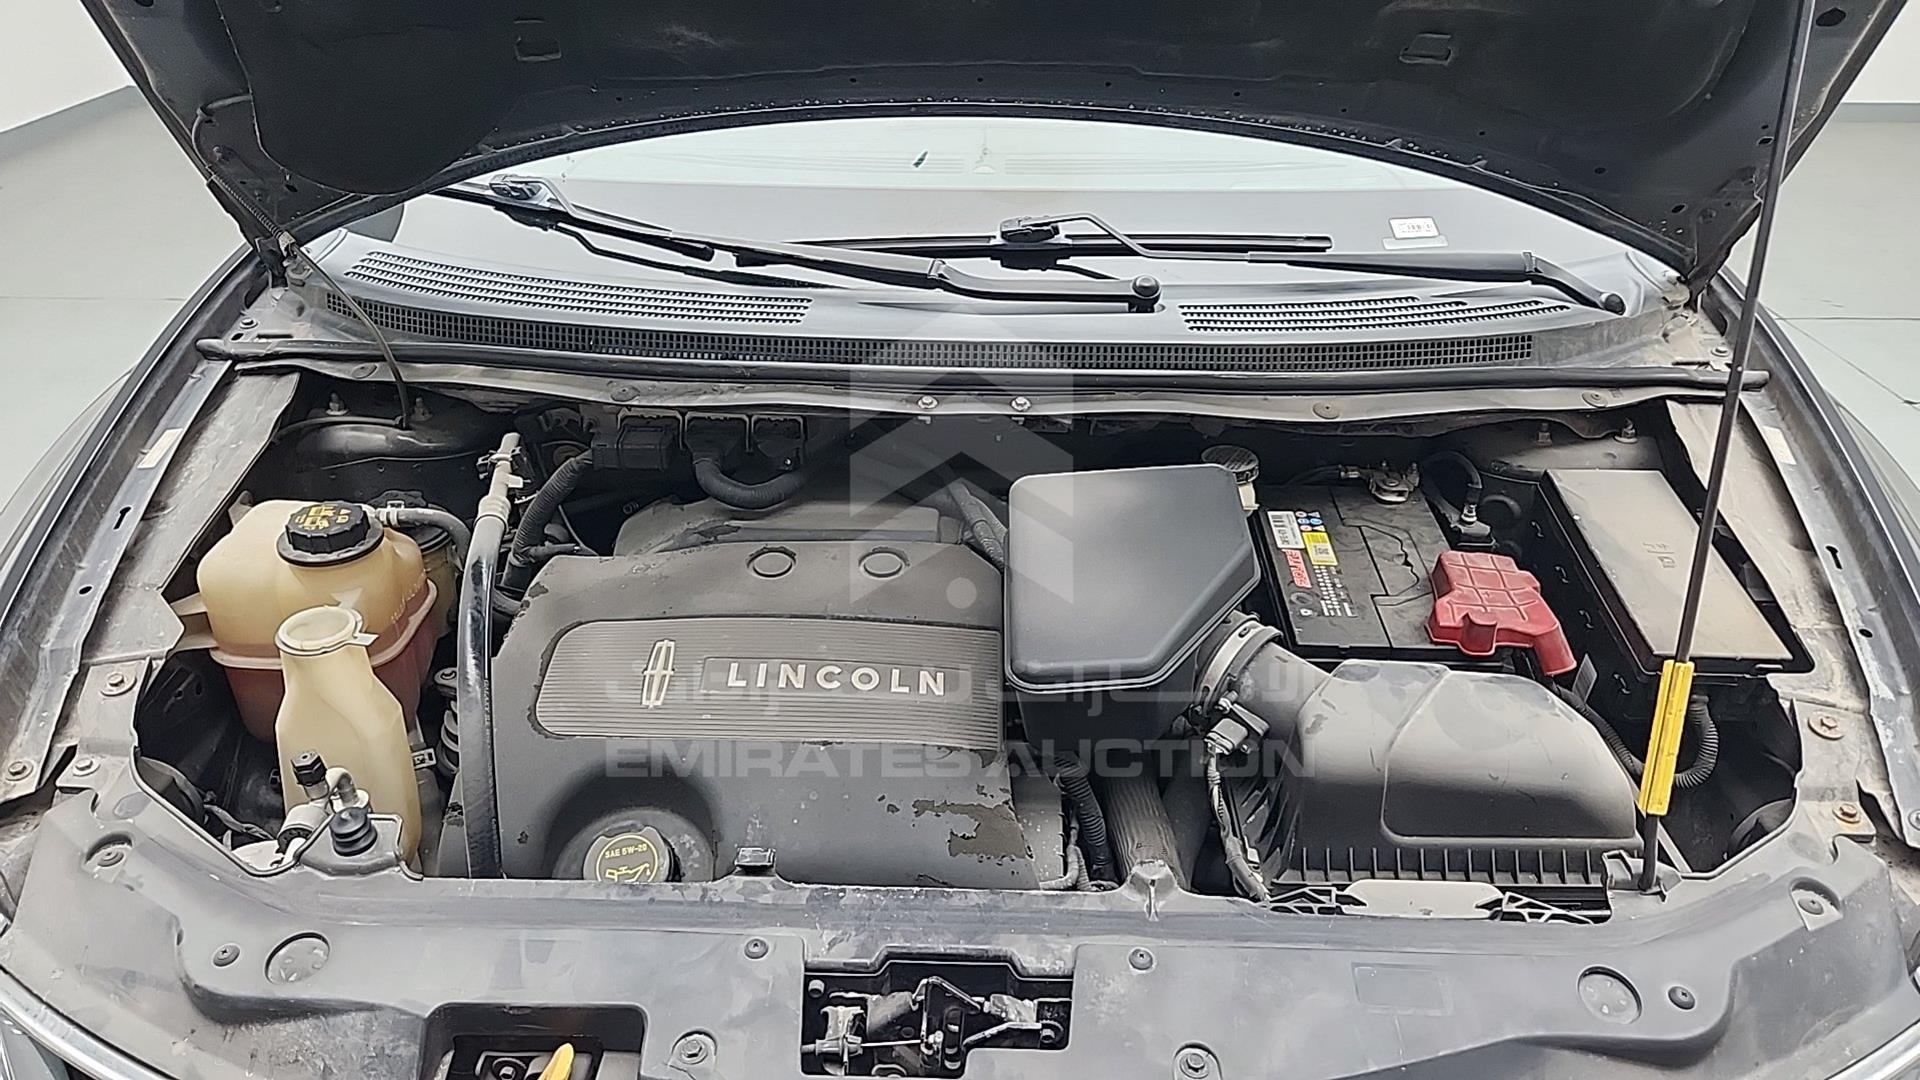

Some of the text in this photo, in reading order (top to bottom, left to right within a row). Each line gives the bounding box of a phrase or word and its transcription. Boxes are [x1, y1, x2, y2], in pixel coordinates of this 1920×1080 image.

[726, 661, 946, 697] LINCOLN
[604, 842, 648, 859] SAE 5W-20
